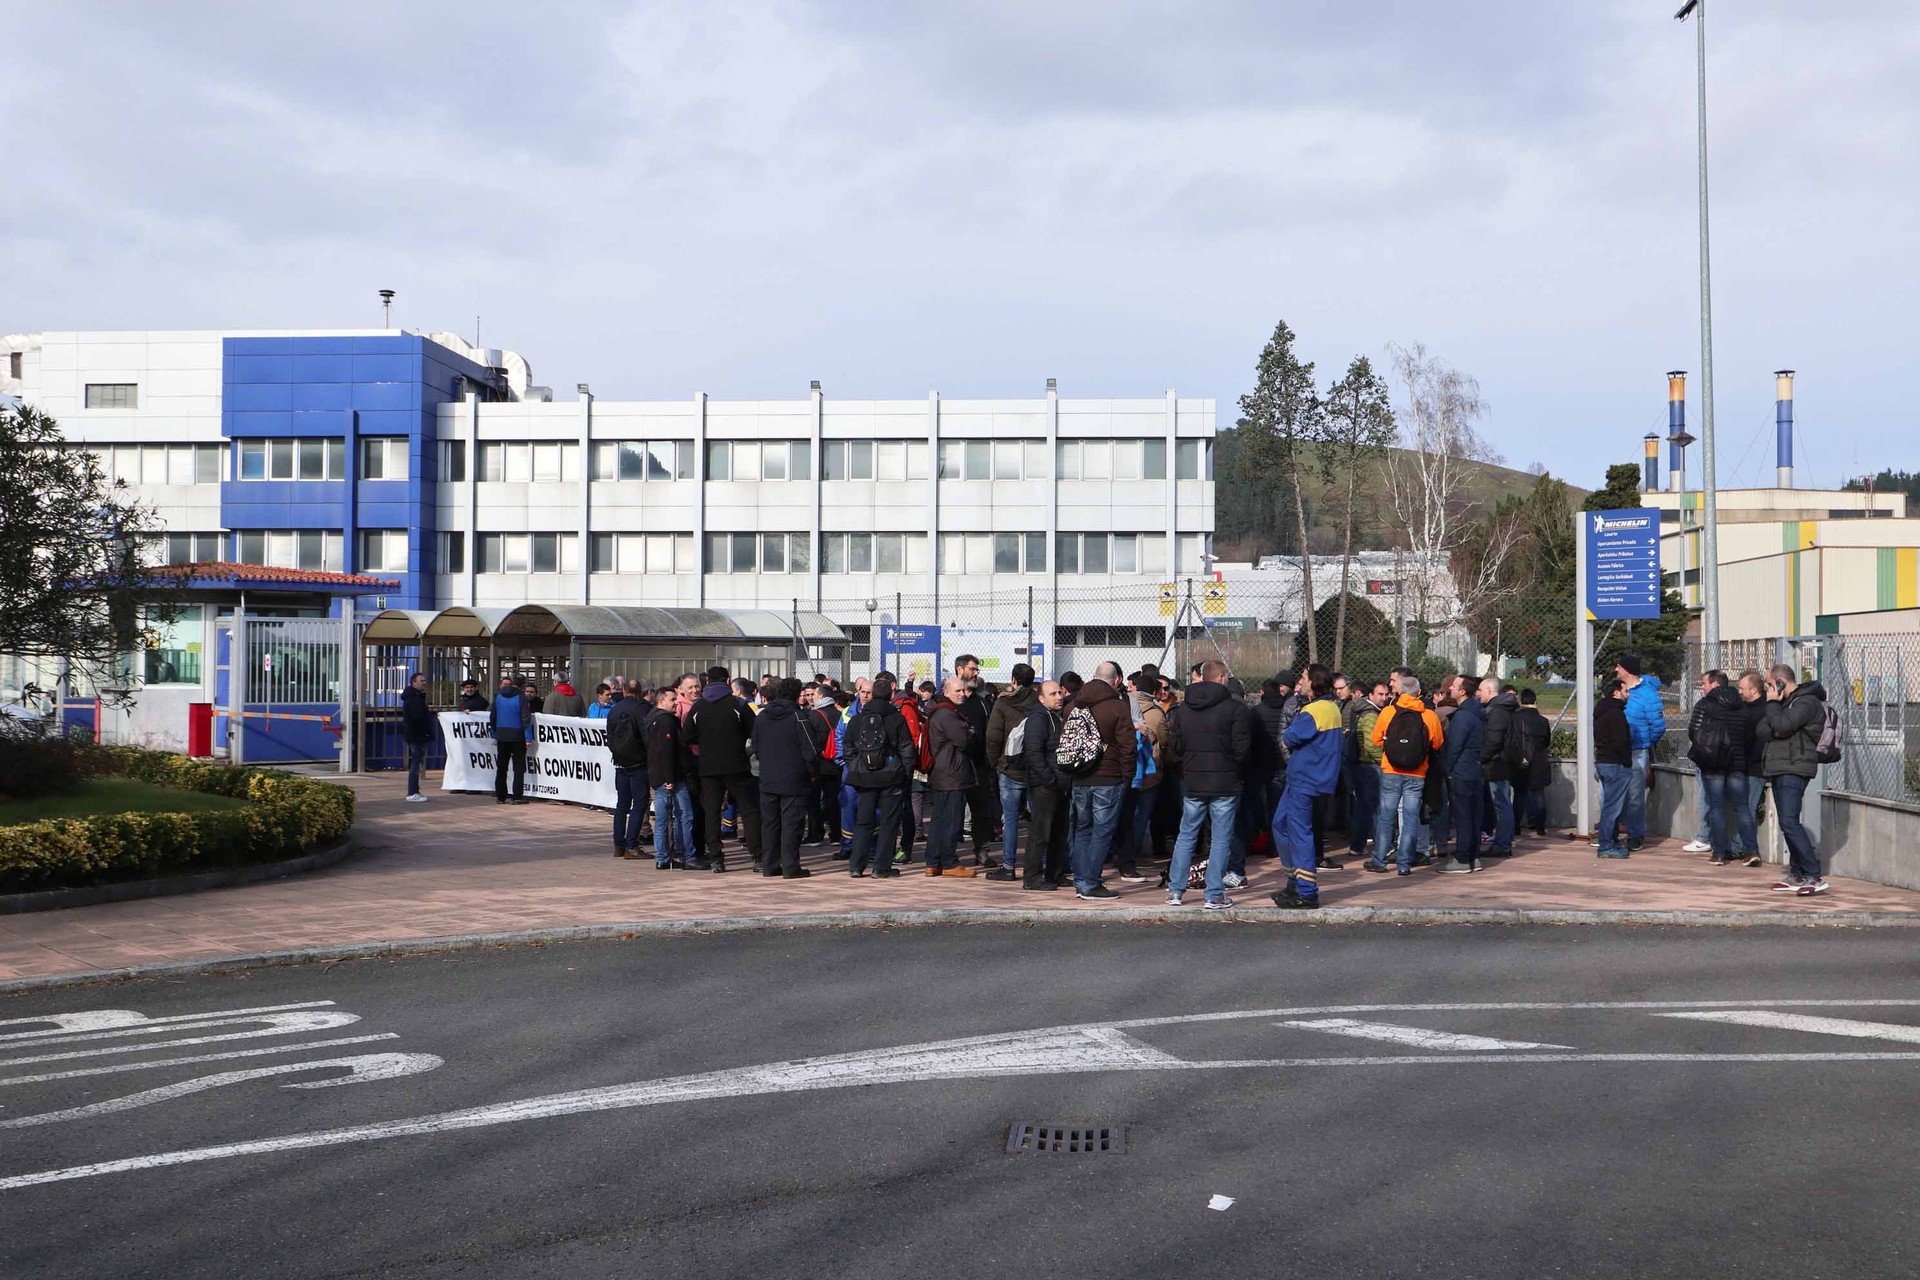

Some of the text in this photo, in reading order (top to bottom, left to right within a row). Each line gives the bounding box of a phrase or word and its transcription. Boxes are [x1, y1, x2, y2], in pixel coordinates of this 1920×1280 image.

[1604, 519, 1648, 528] MICHELIN
[538, 724, 577, 744] BATEN
[469, 749, 494, 770] POR
[544, 757, 602, 782] CONVENIO
